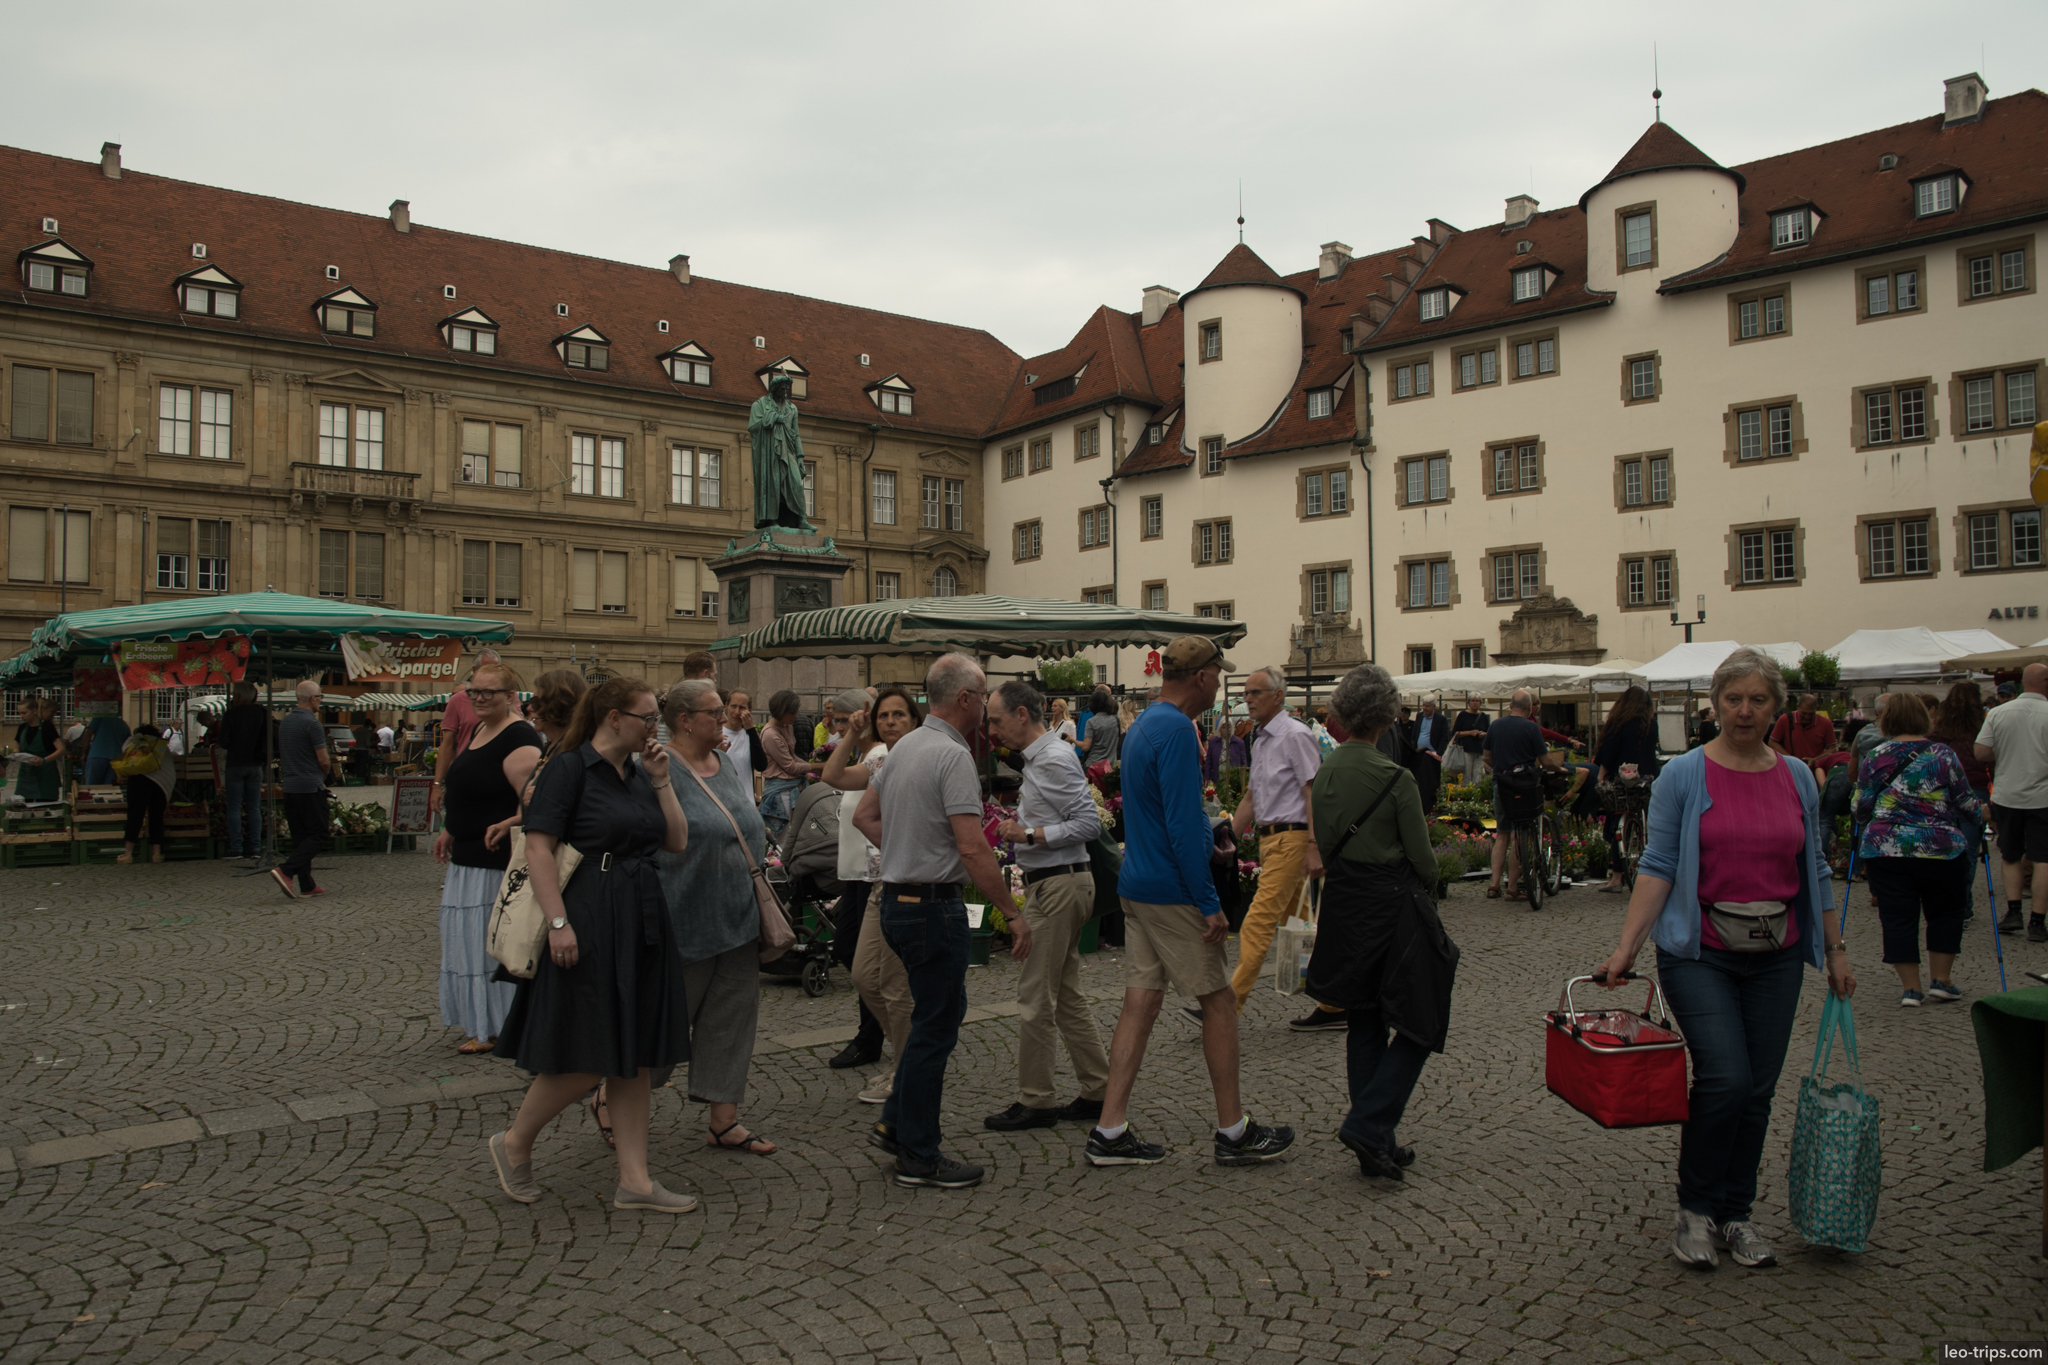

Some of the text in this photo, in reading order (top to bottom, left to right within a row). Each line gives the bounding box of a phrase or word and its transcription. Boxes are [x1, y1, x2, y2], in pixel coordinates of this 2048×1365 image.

[1988, 605, 2039, 620] ALTE
[134, 643, 169, 652] Frische
[380, 641, 445, 658] Frischer
[125, 652, 174, 660] Erdbeeren
[390, 657, 460, 679] Spargel
